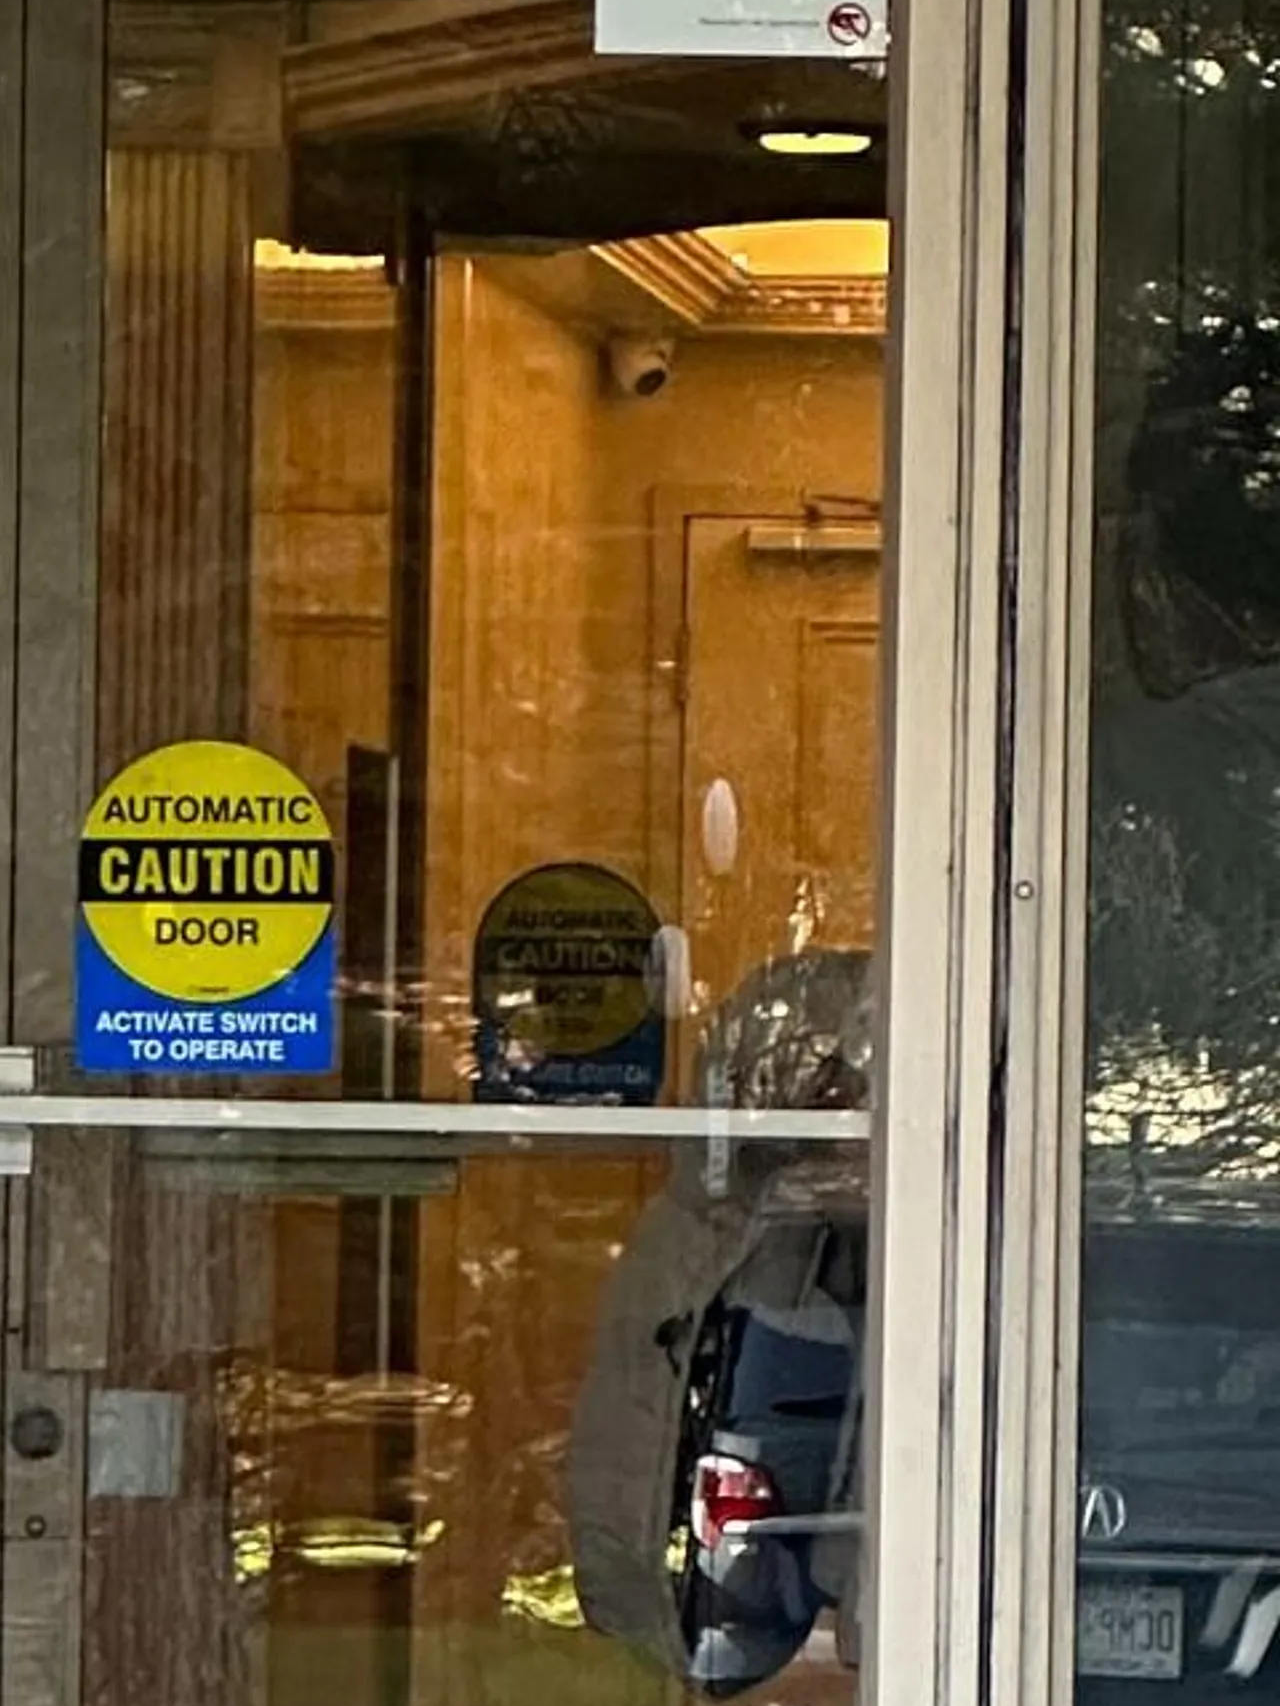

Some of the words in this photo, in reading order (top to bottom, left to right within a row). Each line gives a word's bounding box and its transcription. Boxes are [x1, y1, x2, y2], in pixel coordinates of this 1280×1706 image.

[103, 796, 313, 824] AUTOMATIC
[99, 847, 319, 894] CAUTION
[155, 918, 259, 946] DOOR
[95, 1011, 213, 1033] ACTIVATE
[220, 1012, 318, 1033] SWITCH
[128, 1039, 164, 1061] TO
[169, 1039, 285, 1061] OPERATE
